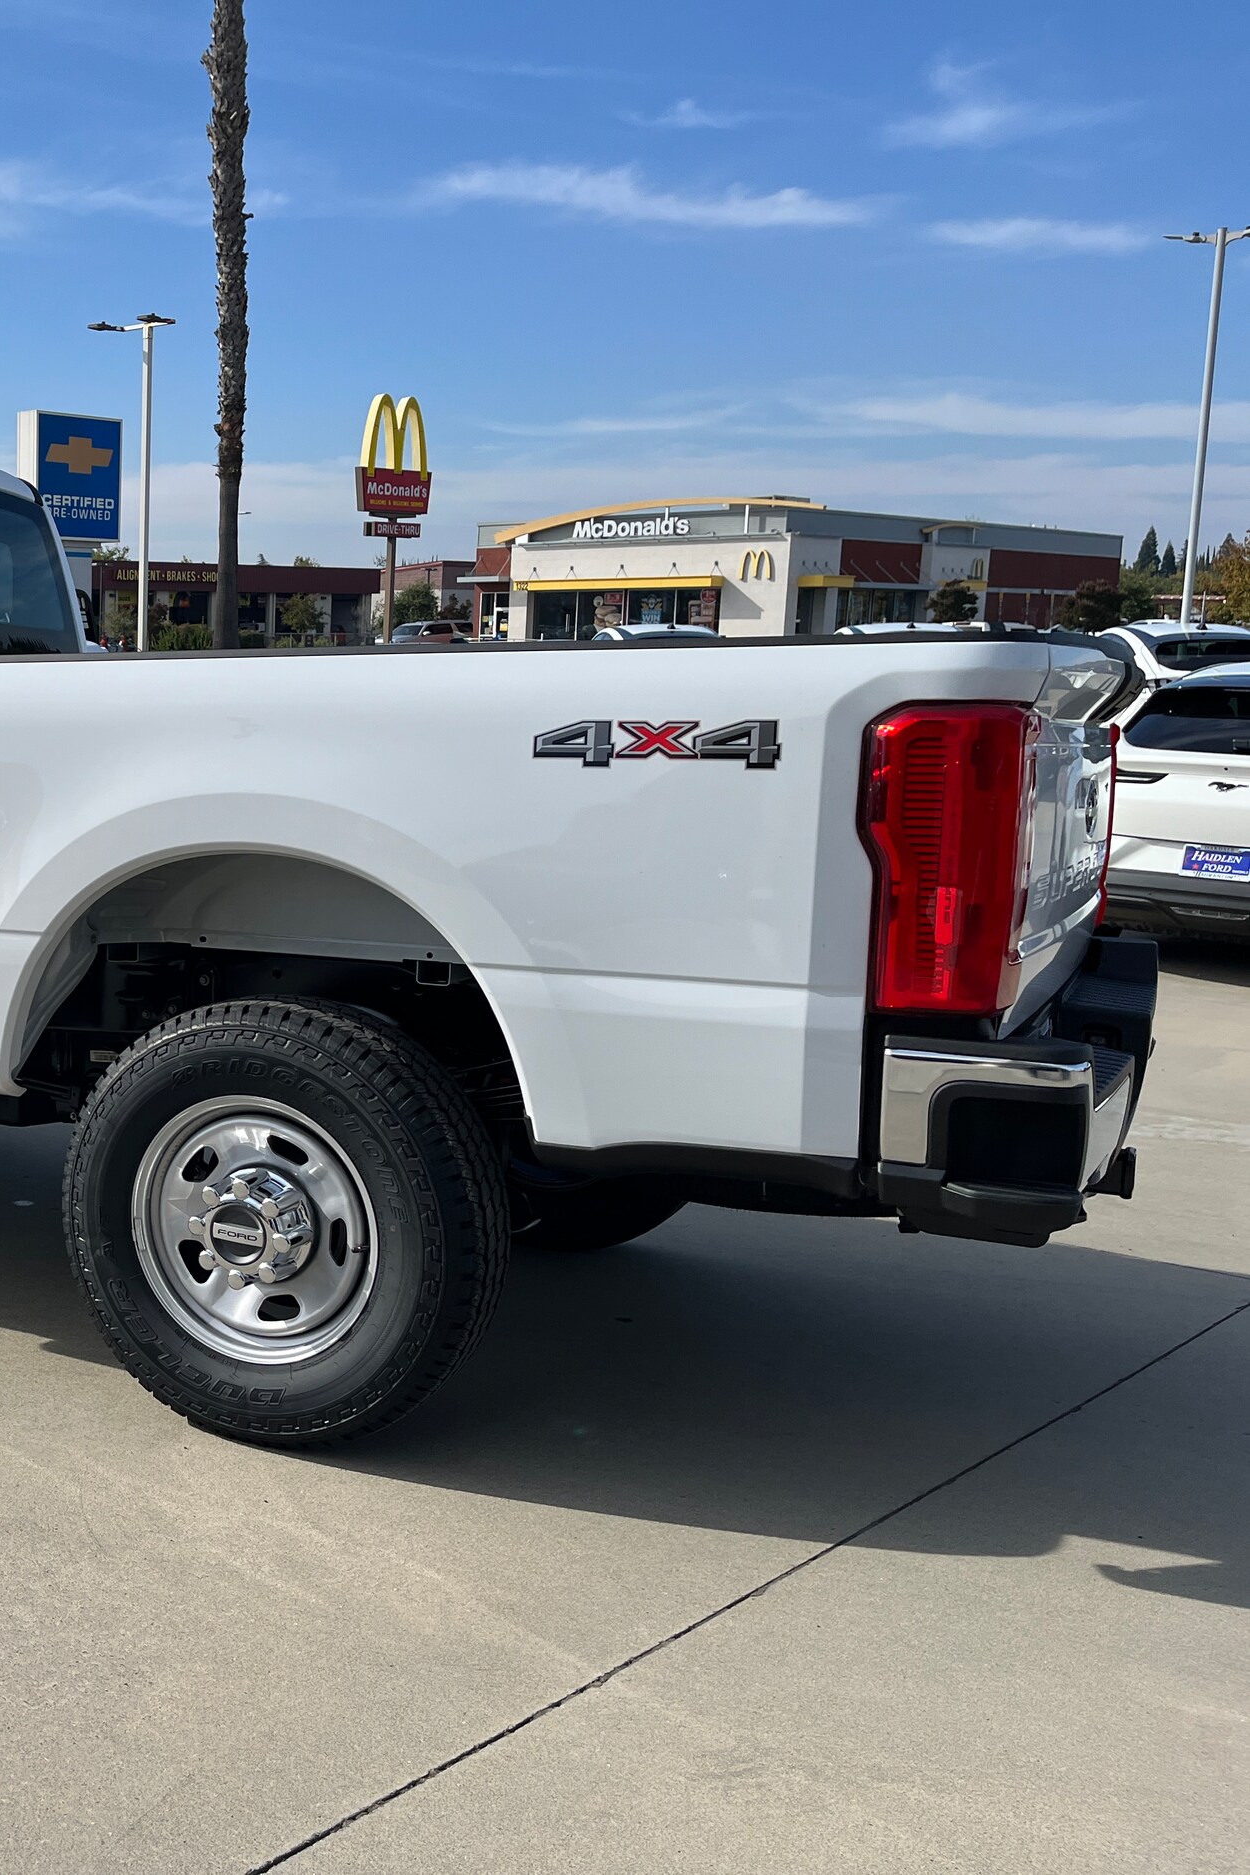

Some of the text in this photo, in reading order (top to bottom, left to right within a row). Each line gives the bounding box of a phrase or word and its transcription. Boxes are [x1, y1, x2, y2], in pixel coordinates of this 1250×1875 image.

[367, 481, 428, 498] McDonald's
[42, 493, 115, 510] CERTIFIED
[377, 523, 420, 536] DRIVE-THRU
[573, 517, 690, 538] McDonald's
[166, 570, 196, 582] BRAKES
[1191, 850, 1243, 864] HAIDLEN
[1202, 863, 1232, 873] FORD
[171, 1056, 412, 1224] BRIDGESTONE
[217, 1228, 258, 1242] FORD
[107, 1278, 287, 1408] DUELER
